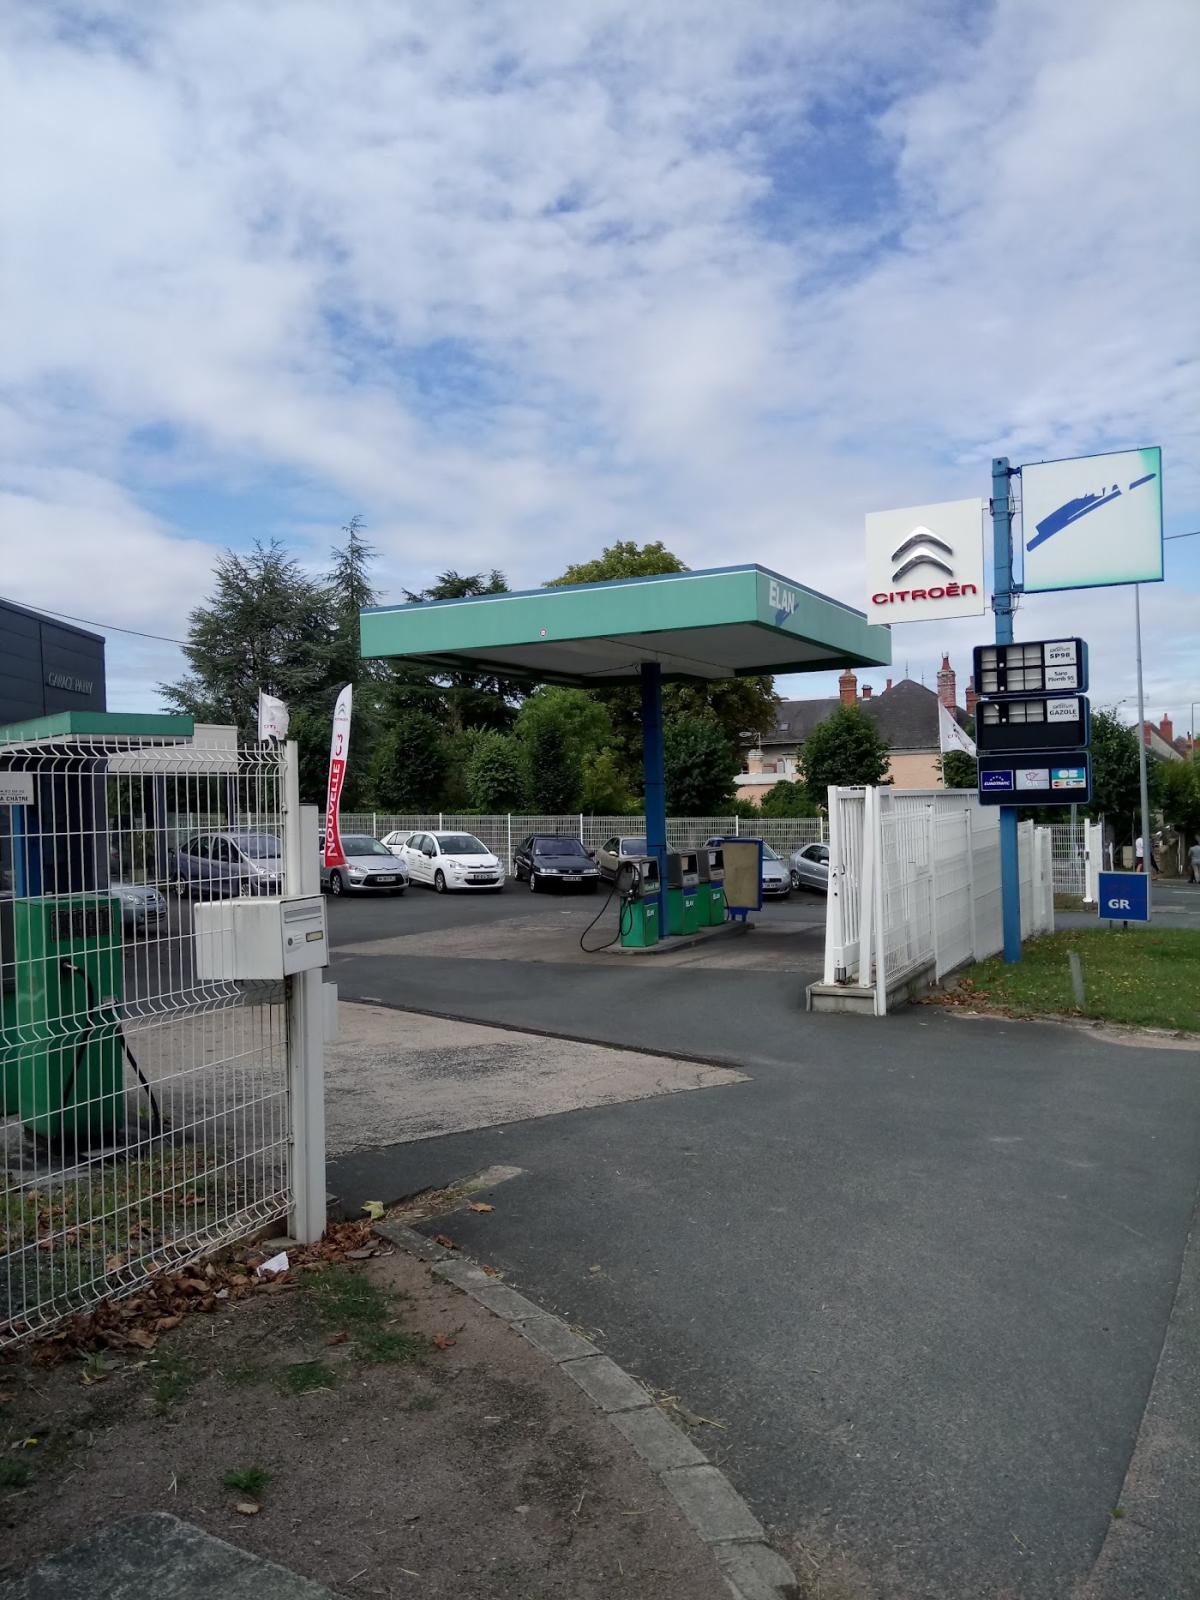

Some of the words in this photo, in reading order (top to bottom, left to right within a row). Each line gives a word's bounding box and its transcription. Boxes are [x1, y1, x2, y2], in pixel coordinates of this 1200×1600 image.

[769, 580, 795, 614] ELAN
[327, 763, 341, 857] NOUVELLE
[335, 733, 344, 757] C3
[1108, 899, 1131, 910] GR
